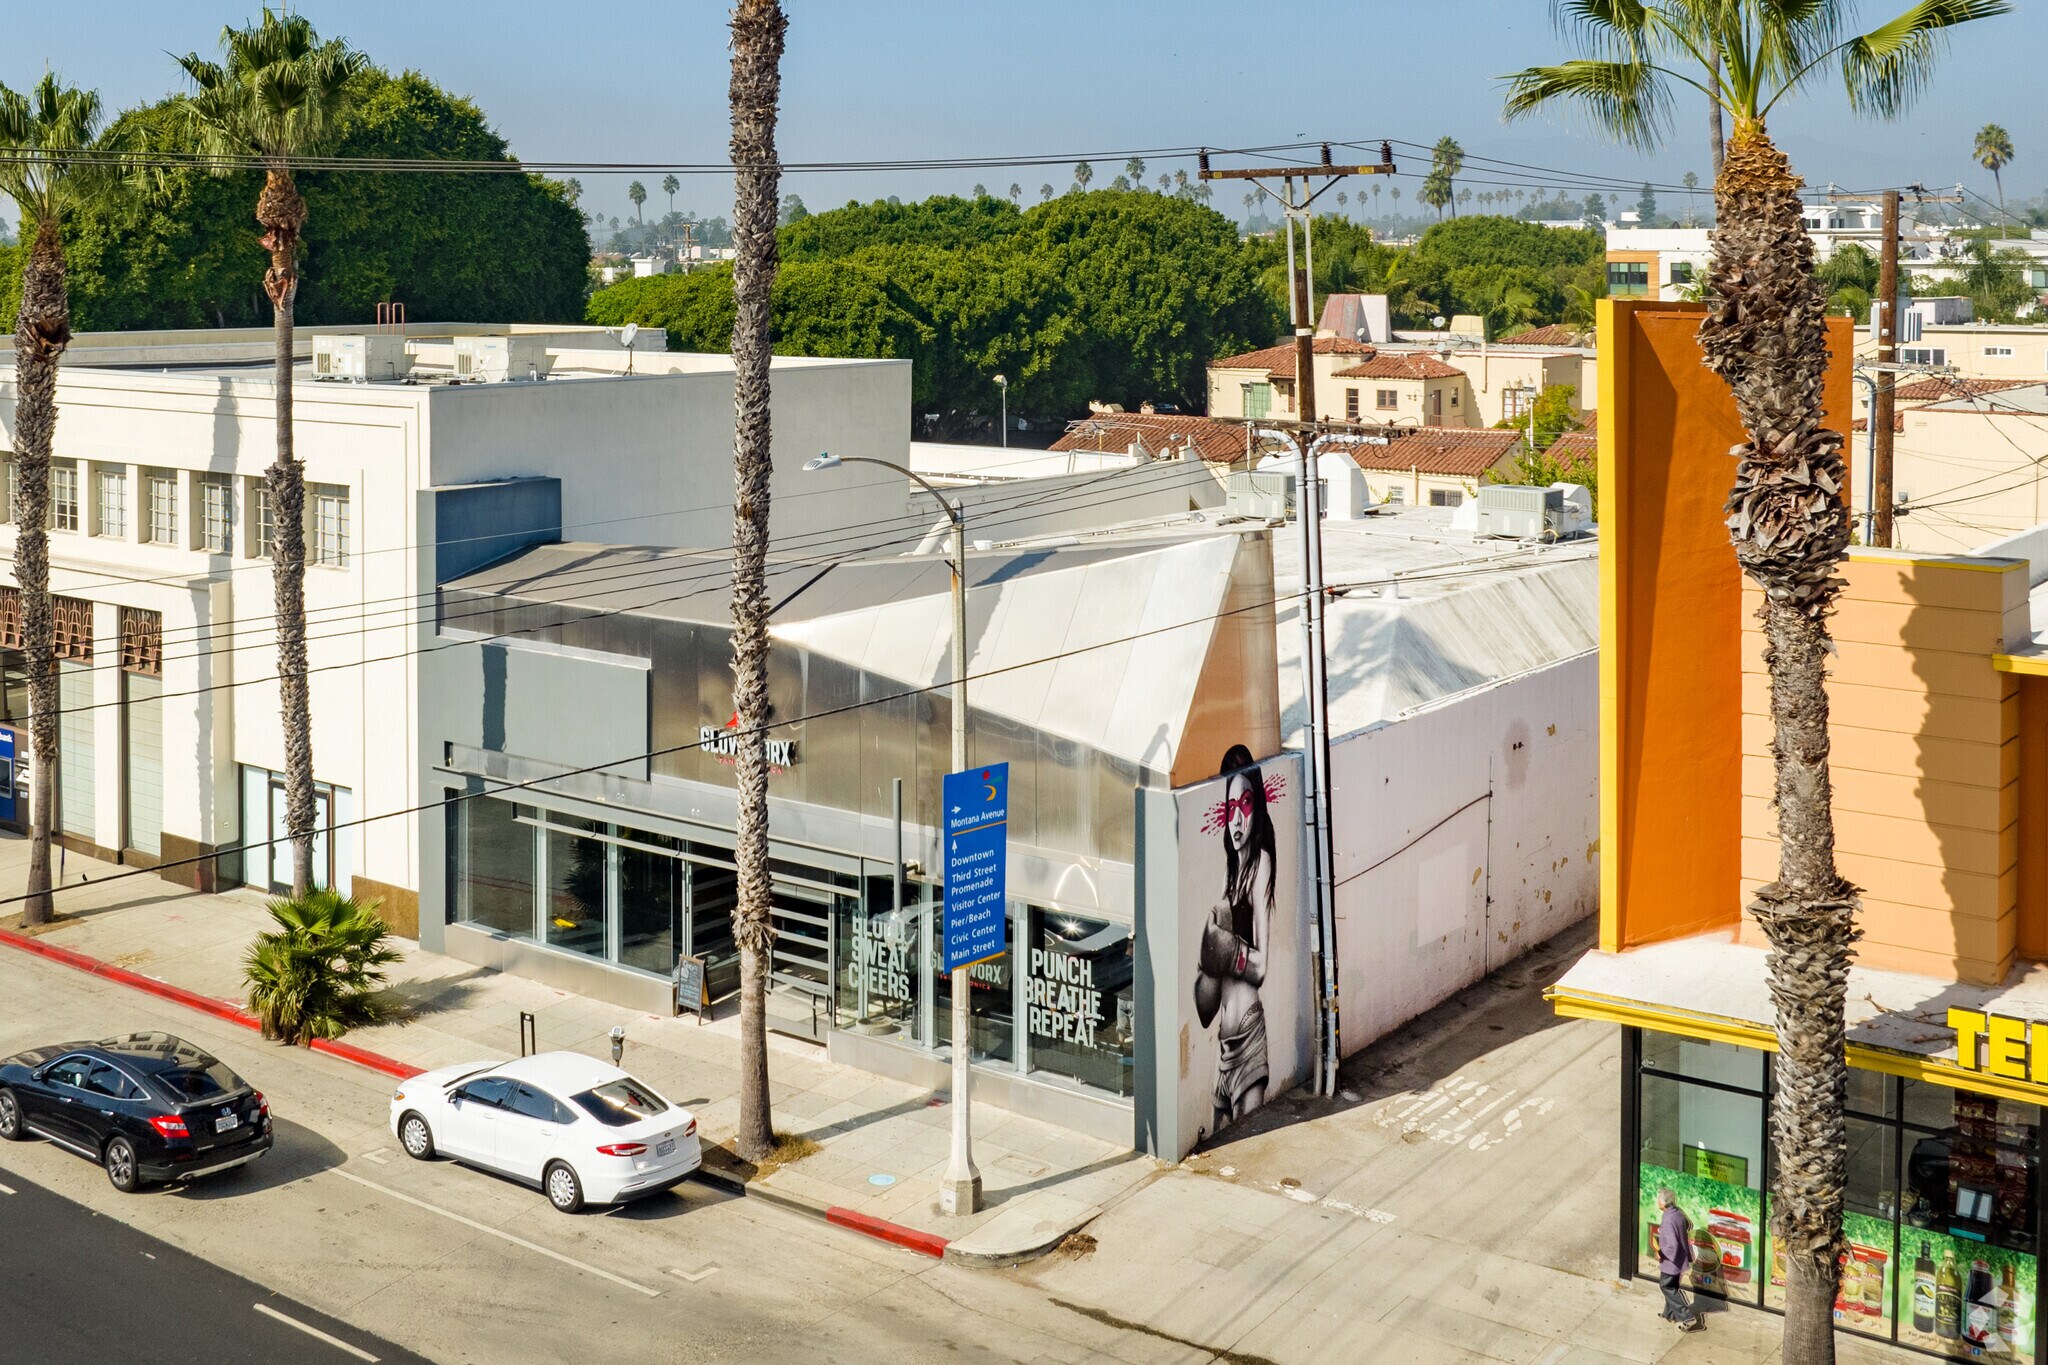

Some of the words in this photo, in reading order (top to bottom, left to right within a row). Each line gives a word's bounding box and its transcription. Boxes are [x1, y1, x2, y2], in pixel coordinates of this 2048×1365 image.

[700, 726, 792, 767] GLOVRX
[951, 815, 980, 829] Montana
[981, 809, 1005, 821] Avenue
[951, 849, 995, 868] Downtown
[951, 869, 972, 883] Third
[974, 863, 997, 878] Street
[951, 877, 994, 897] Promenade
[951, 900, 975, 912] Visitor
[977, 891, 1001, 904] Center
[951, 908, 991, 929] Pier/Beach
[951, 932, 969, 945] Civic
[971, 924, 996, 938] Center
[951, 947, 970, 961] Main
[972, 940, 995, 954] Street
[930, 951, 1002, 985] GLWORX
[1031, 947, 1095, 989] PUNCH.
[1024, 976, 1105, 1021] BREATHE.
[1029, 1006, 1097, 1050] REPEAT.
